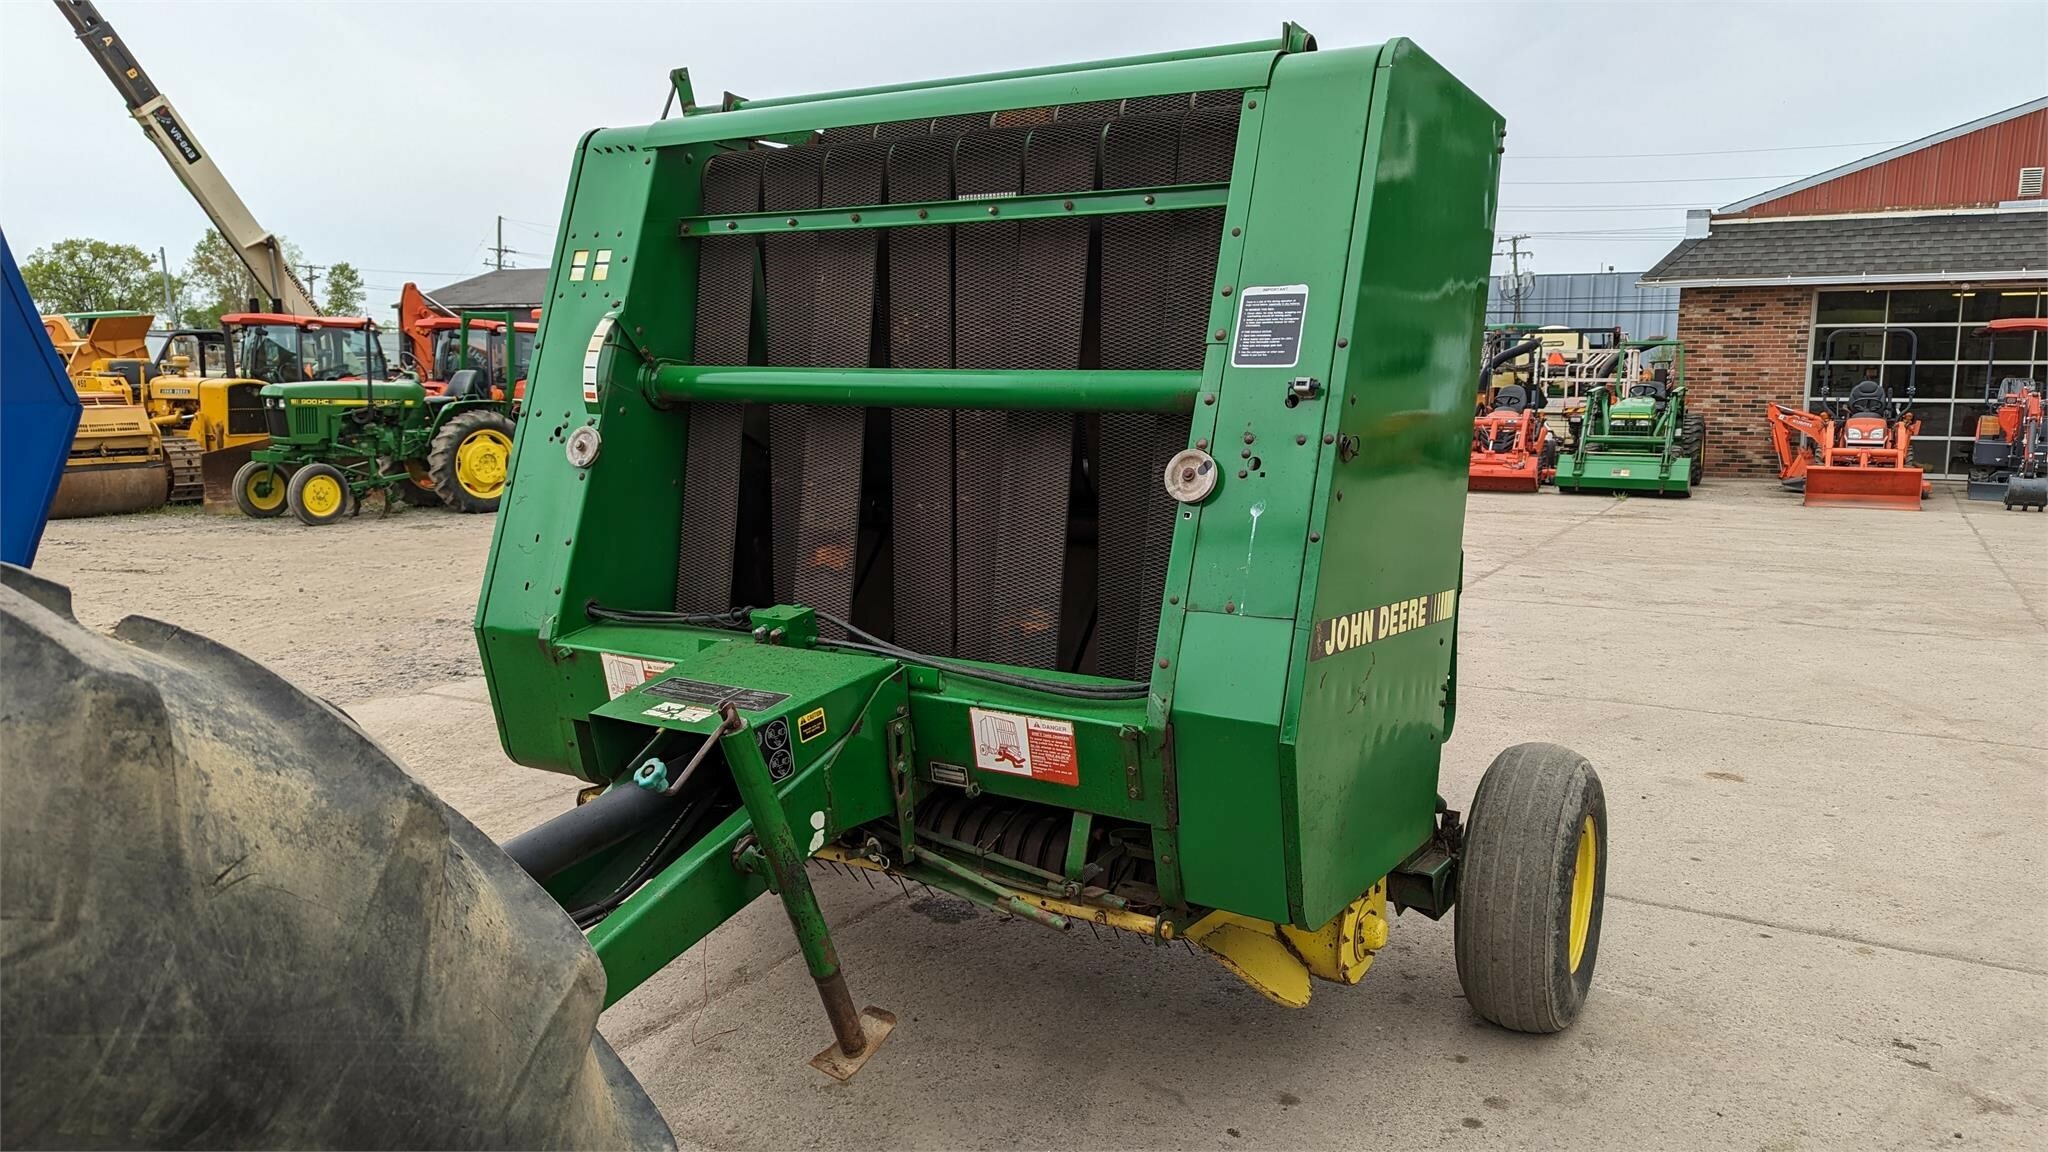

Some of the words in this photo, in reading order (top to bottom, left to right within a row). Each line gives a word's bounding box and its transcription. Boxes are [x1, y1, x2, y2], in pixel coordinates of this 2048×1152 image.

[102, 36, 113, 47] A
[126, 67, 138, 79] B
[1325, 609, 1375, 656] JOHN
[1378, 595, 1428, 640] DEERE
